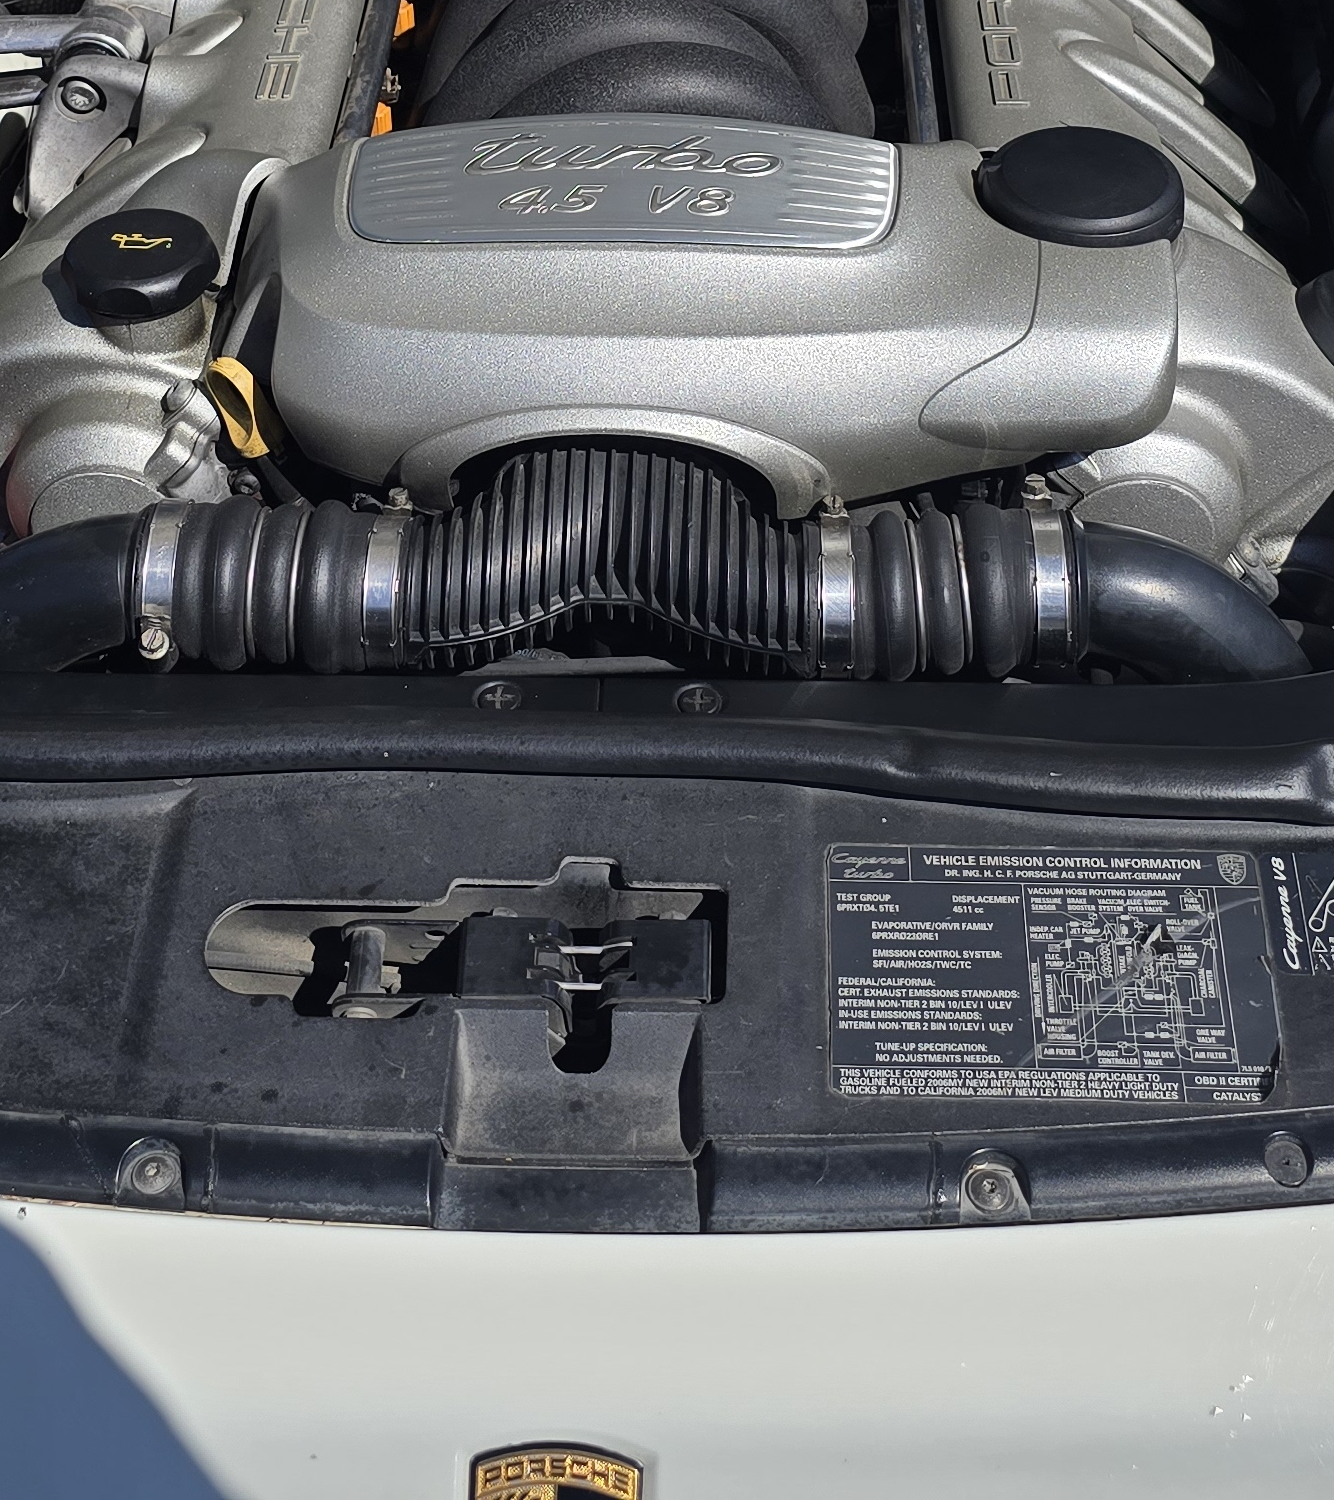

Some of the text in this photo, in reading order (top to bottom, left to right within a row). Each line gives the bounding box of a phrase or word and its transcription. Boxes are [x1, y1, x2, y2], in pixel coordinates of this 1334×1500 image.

[464, 132, 783, 178] turbo
[498, 184, 737, 216] 4.5 V8
[923, 855, 1201, 870] VEHICLE EMISSION CONTROL INFORMATION
[945, 869, 960, 877] DR.
[1007, 870, 1013, 878] F.
[1016, 870, 1059, 878] PORSCHE
[1061, 871, 1075, 879] AG
[1077, 872, 1181, 880] STUTTGART-GERMANY
[836, 893, 858, 901] TEST
[952, 895, 1020, 904] DISPLACEMENT
[1271, 857, 1303, 970] Cayenne V8
[871, 921, 993, 931] EVAPORATIVE/ORVR FAMILY
[873, 949, 1002, 959] EMISSION CONTROL SYSTEM:
[838, 977, 935, 987] FEDERAL/CALIFORNIA:
[838, 988, 1020, 998] CERT. EXHAUST EMISSIONS STANDARDS:
[839, 999, 875, 1007] INTERIM
[877, 1000, 920, 1008] NON-TIER
[922, 1000, 928, 1008] 2
[930, 1000, 945, 1008] BIN
[988, 1001, 1012, 1009] ULEV
[839, 1010, 982, 1020] IN-USE EMISSIONS STANDARDS:
[839, 1021, 876, 1029] INTERIM
[878, 1021, 921, 1030] NON-TIER
[923, 1022, 928, 1030] 2
[931, 1022, 946, 1030] BIN
[989, 1023, 1013, 1031] ULEV
[875, 1042, 987, 1052] TUNE-UP SPECIFICATION:
[876, 1054, 1003, 1063] NO ADJUSTMENTS NEEDED.
[840, 1069, 1160, 1082] THIS VEHICLE CONFORMS TO USA EPA REGULATIONS APPLICABLE TO
[840, 1078, 887, 1086] GASOLINE
[889, 1078, 925, 1086] FUELED
[927, 1079, 963, 1087] 2006MY
[965, 1079, 988, 1087] NEW
[991, 1079, 1030, 1088] INTERIM
[1033, 1080, 1078, 1088] NON-TIER
[1088, 1082, 1120, 1090] HEAVY
[1123, 1082, 1150, 1090] LIGHT
[1153, 1083, 1178, 1091] DUTY
[1195, 1077, 1217, 1085] OBD
[840, 1086, 877, 1094] TRUCKS
[879, 1086, 900, 1094] AND
[903, 1087, 916, 1095] TO
[918, 1087, 975, 1095] CALIFORNIA
[977, 1088, 1013, 1096] 2006MY
[1015, 1088, 1037, 1096] NEW
[1061, 1089, 1101, 1097] MEDIUM
[1104, 1090, 1129, 1098] DUTY
[1132, 1091, 1178, 1099] VEHICLES
[1213, 1092, 1262, 1101] CATALYS
[484, 1457, 629, 1492] PORSCHE
